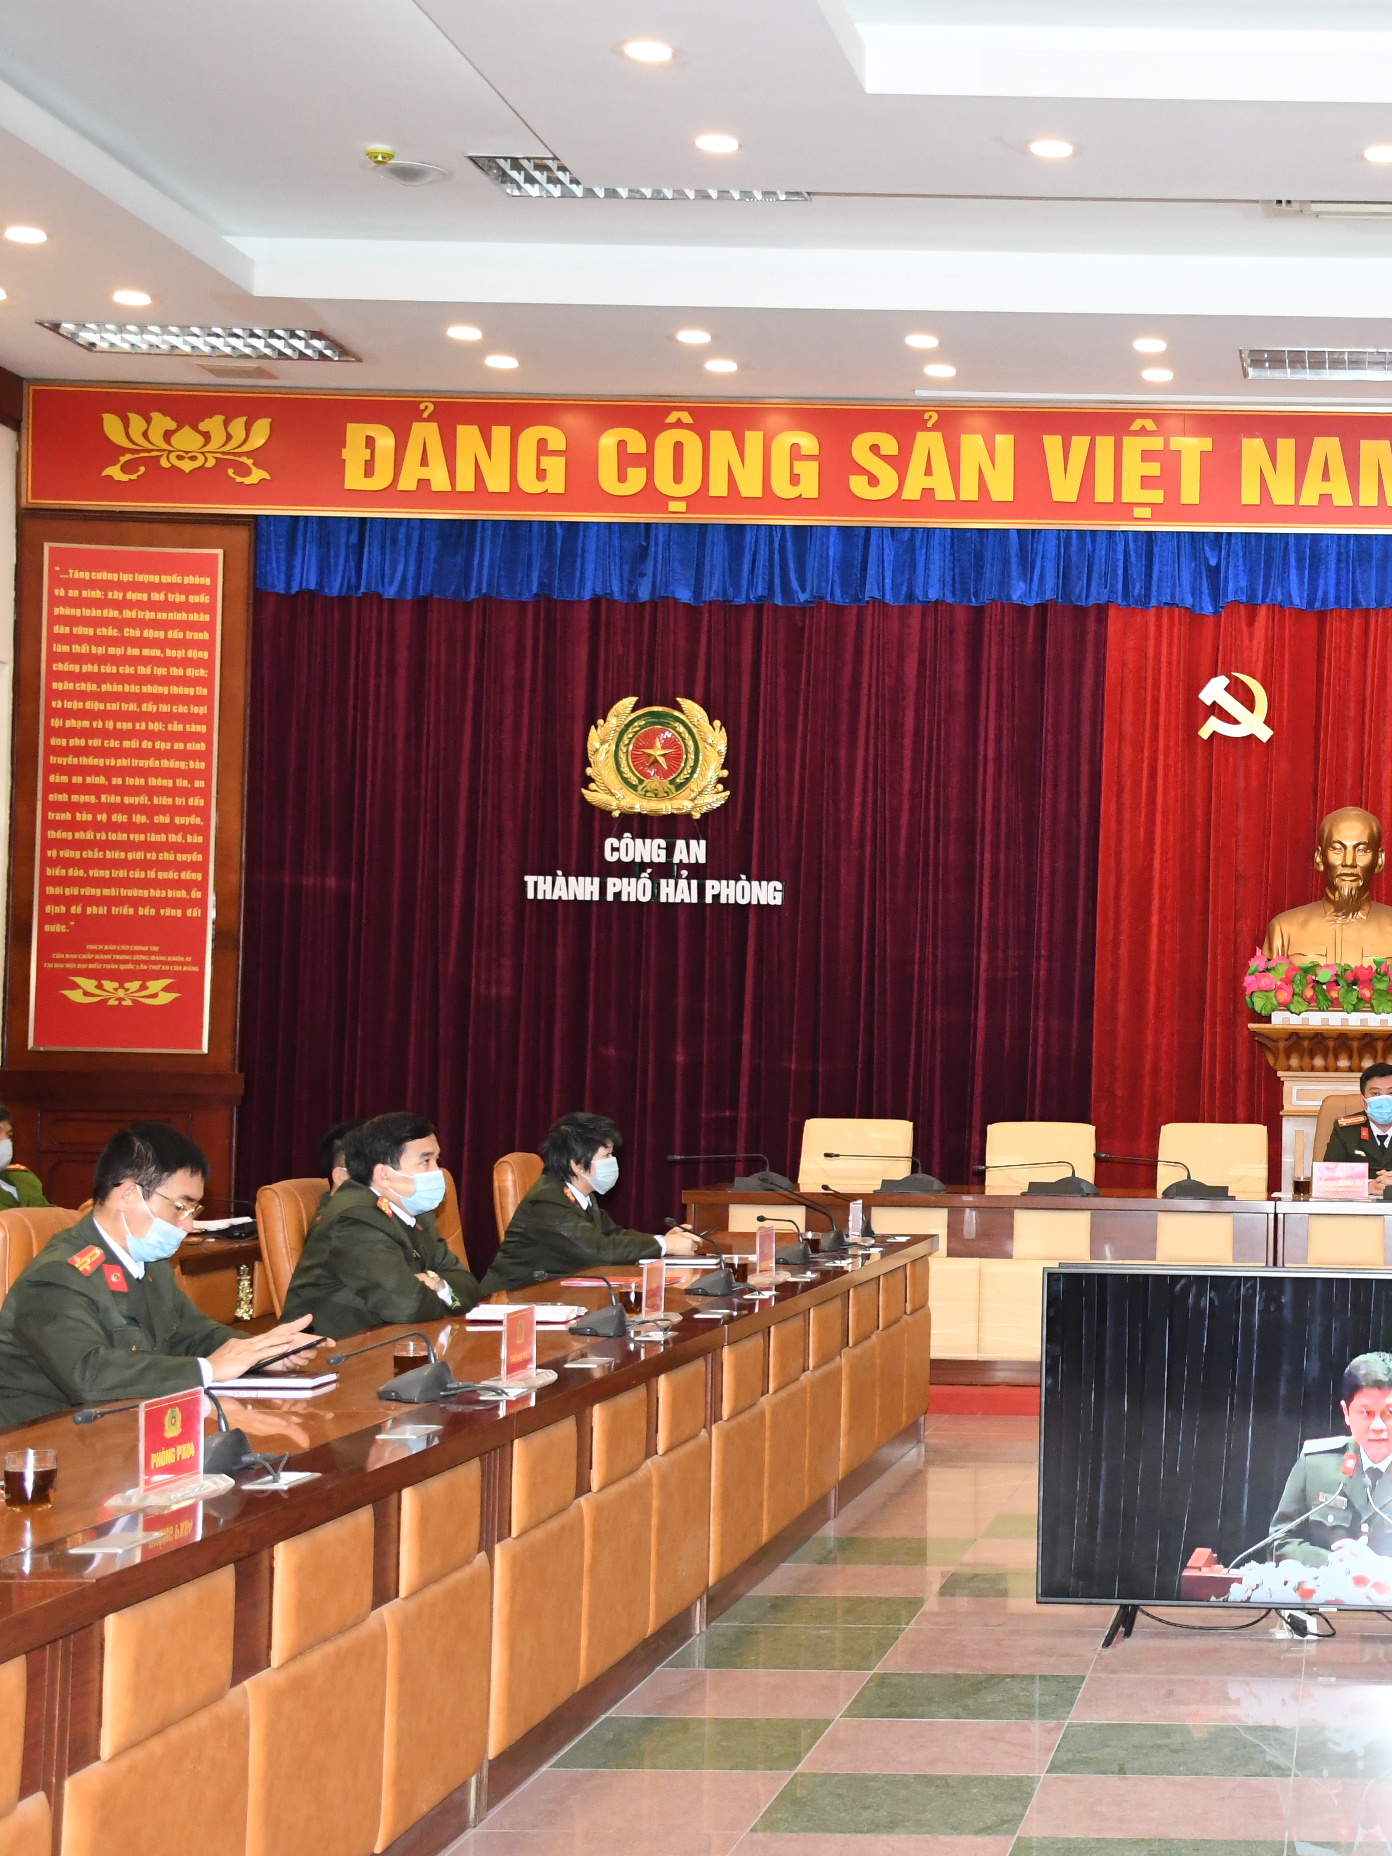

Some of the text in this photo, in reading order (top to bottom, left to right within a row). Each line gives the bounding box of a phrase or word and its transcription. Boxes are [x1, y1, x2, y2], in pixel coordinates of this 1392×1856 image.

[341, 401, 567, 495] ĐẢNG
[597, 411, 821, 513] CỘNG
[848, 411, 1015, 502] SẢN
[1042, 418, 1213, 520] VIỆT
[604, 832, 707, 864] CÔNG AN
[524, 868, 783, 905] THÀNH PHỐ HẢI PHÒNG
[151, 1442, 195, 1469] PHÒNG PX04
